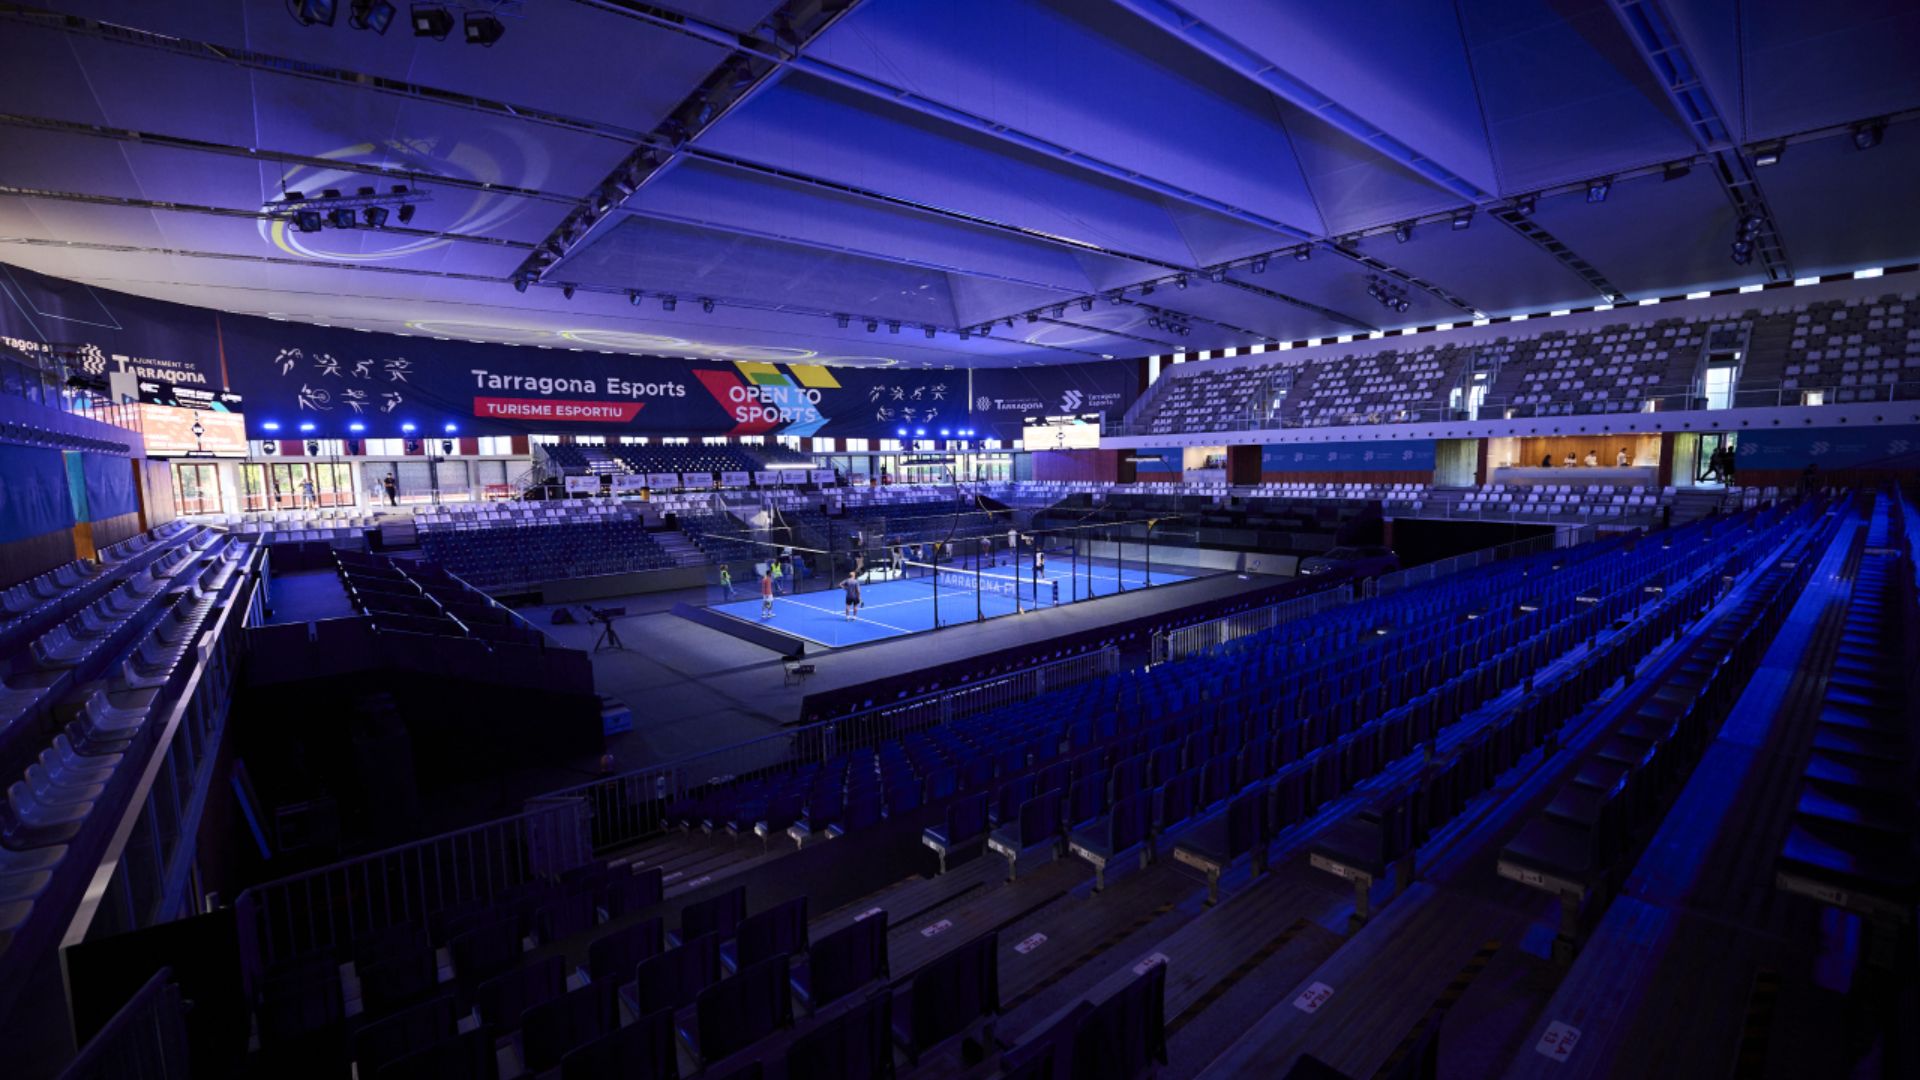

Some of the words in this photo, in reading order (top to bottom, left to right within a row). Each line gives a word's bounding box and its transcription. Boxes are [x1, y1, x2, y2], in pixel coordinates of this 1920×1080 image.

[471, 369, 596, 395] Tarragona
[606, 377, 686, 399] Esports
[729, 385, 788, 403] OPEN
[794, 388, 822, 405] TO
[487, 402, 552, 416] TURISME
[555, 404, 622, 417] ESPORTIU
[735, 405, 816, 423] SPORTS
